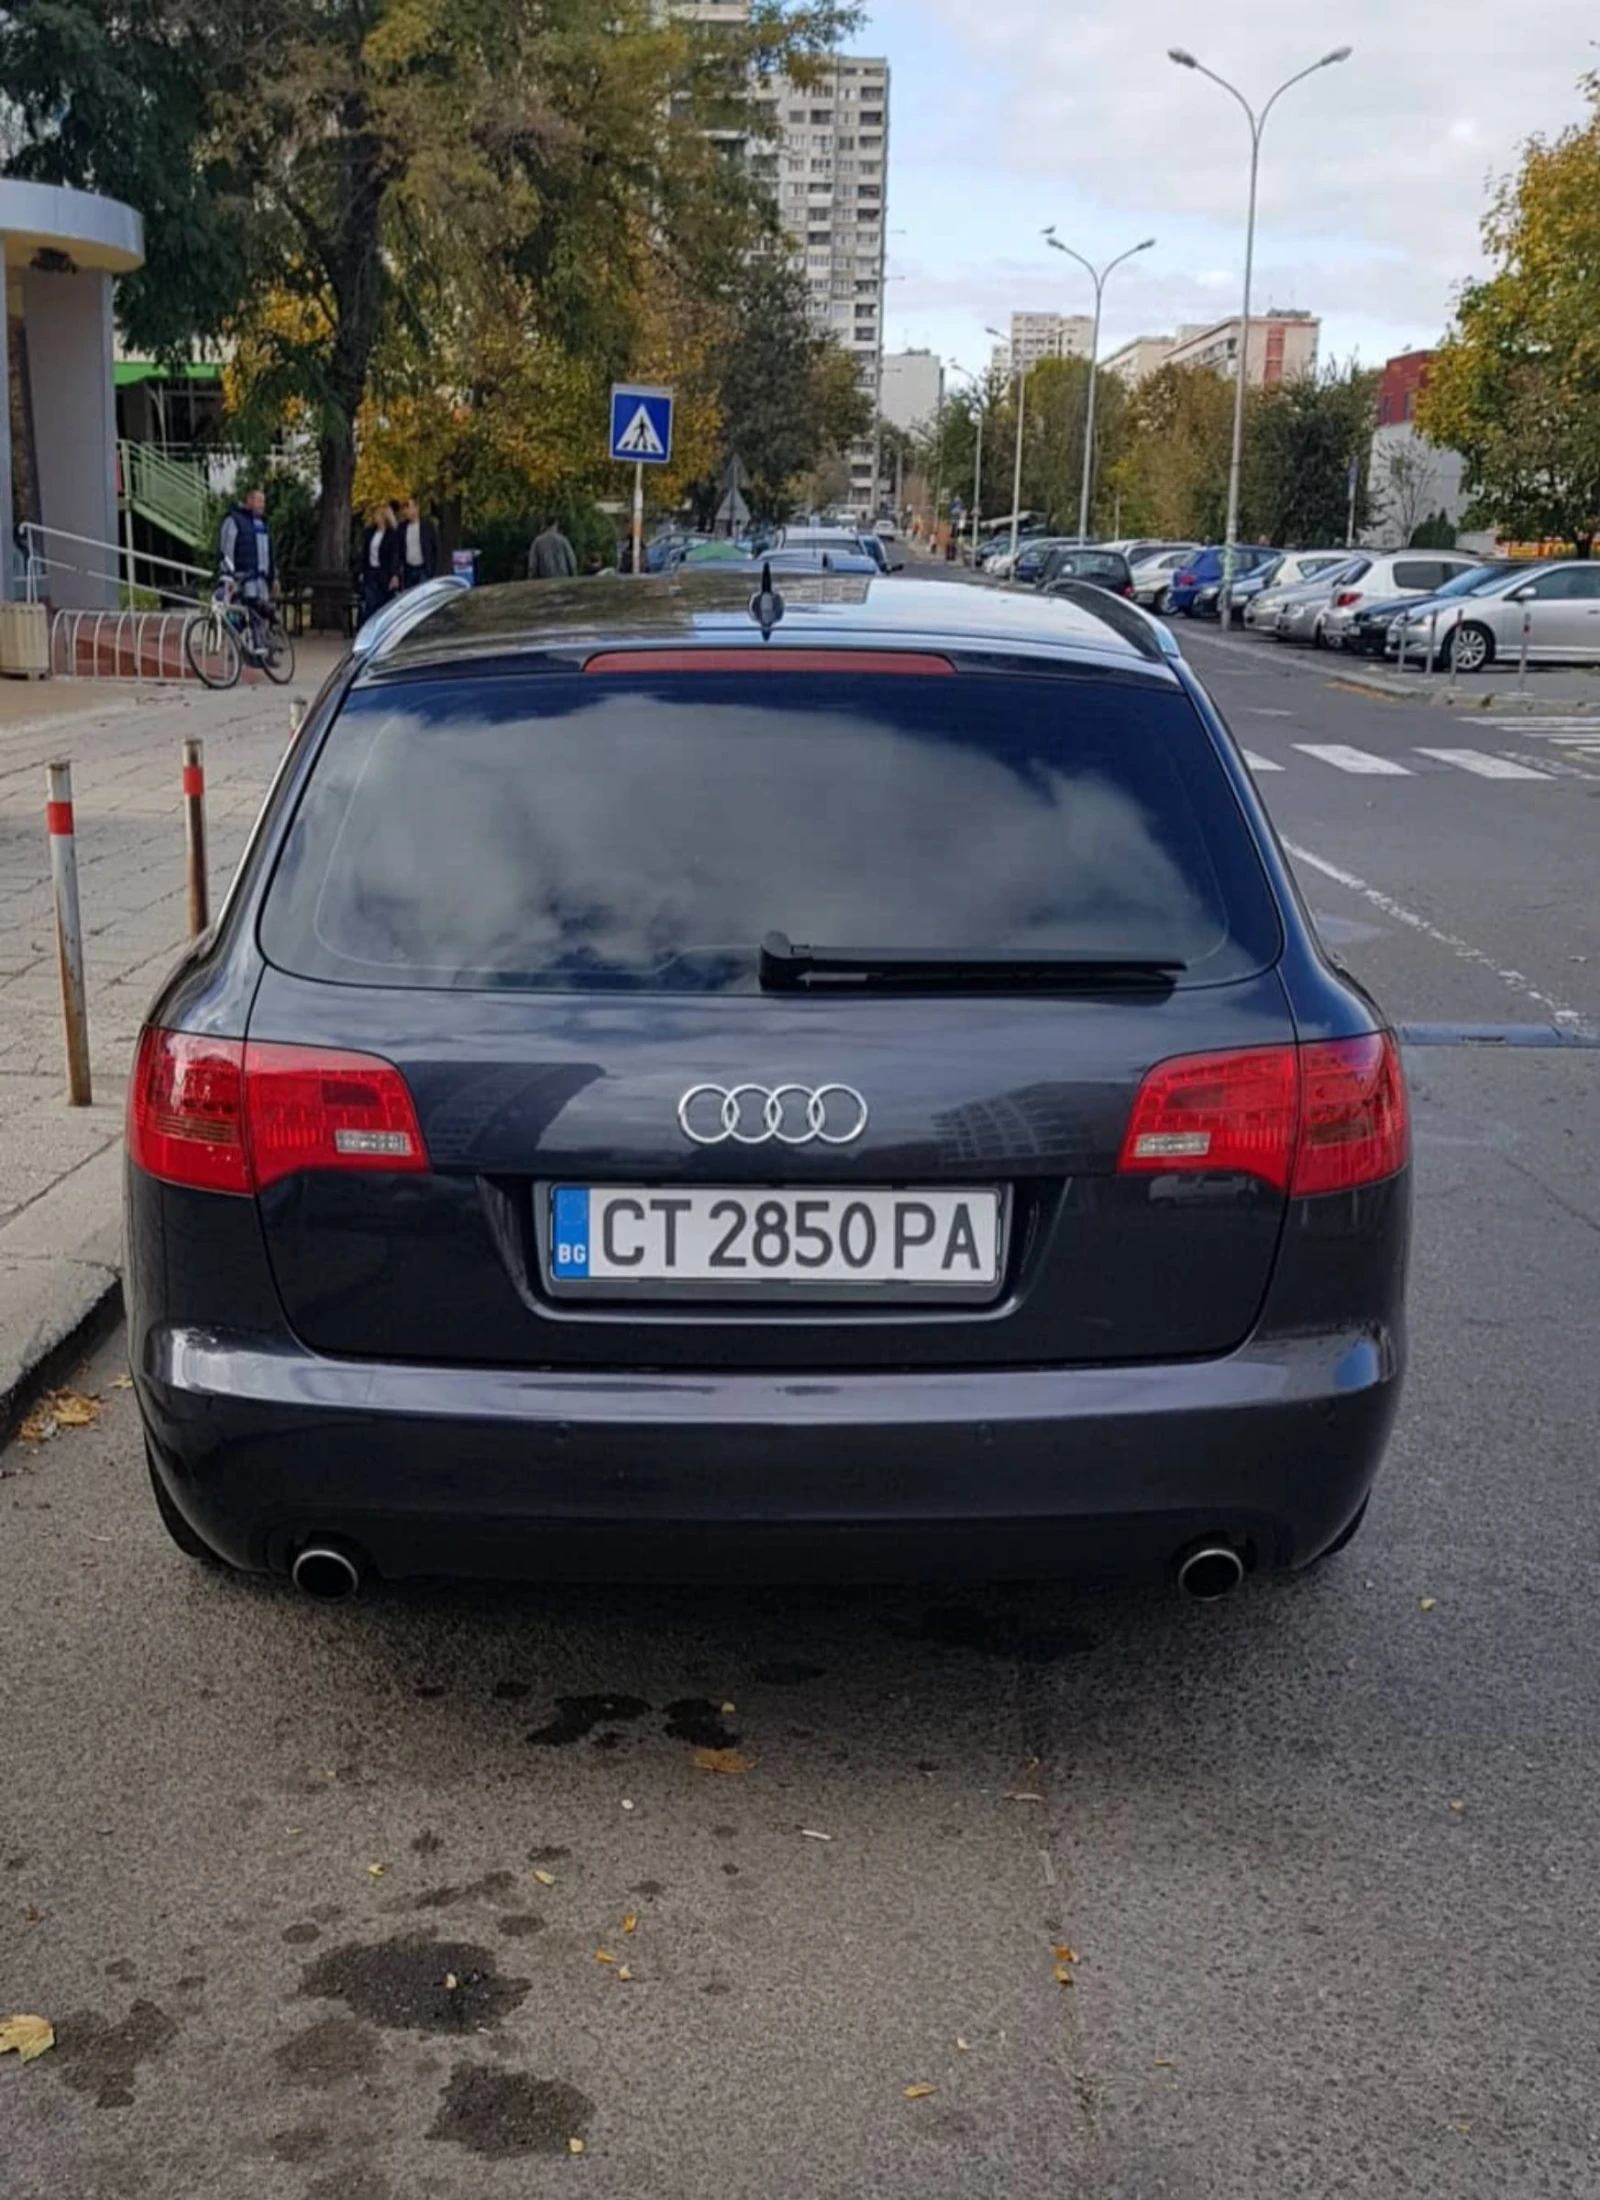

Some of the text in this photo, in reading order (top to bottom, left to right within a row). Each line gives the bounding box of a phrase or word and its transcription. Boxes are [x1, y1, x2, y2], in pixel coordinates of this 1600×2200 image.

[559, 1244, 586, 1262] BG
[603, 1198, 981, 1270] CT 2850 PA
